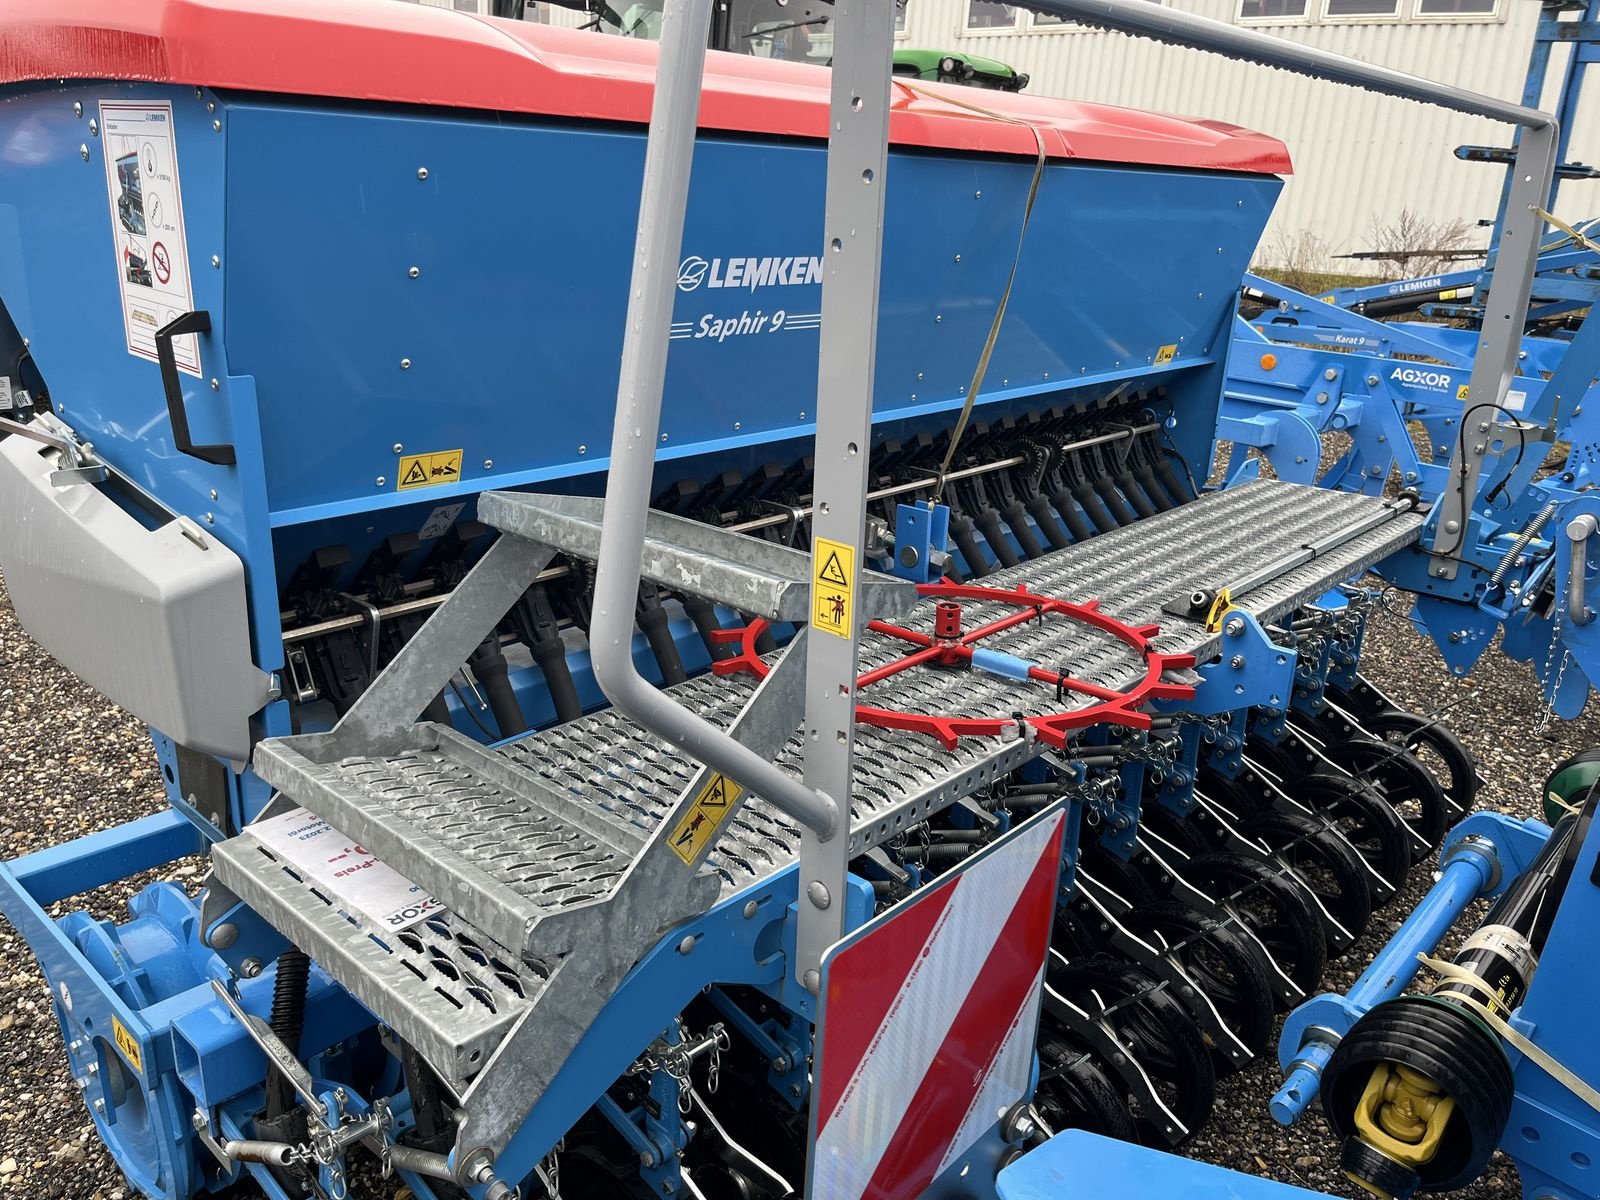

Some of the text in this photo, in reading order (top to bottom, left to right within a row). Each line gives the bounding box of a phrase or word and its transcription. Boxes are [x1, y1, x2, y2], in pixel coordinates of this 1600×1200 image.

[707, 256, 825, 294] LEMKEN
[1399, 278, 1441, 292] LEMKEN
[694, 310, 786, 342] Saphir 9
[1335, 334, 1365, 345] Karat 9
[1390, 367, 1451, 388] AGXOR
